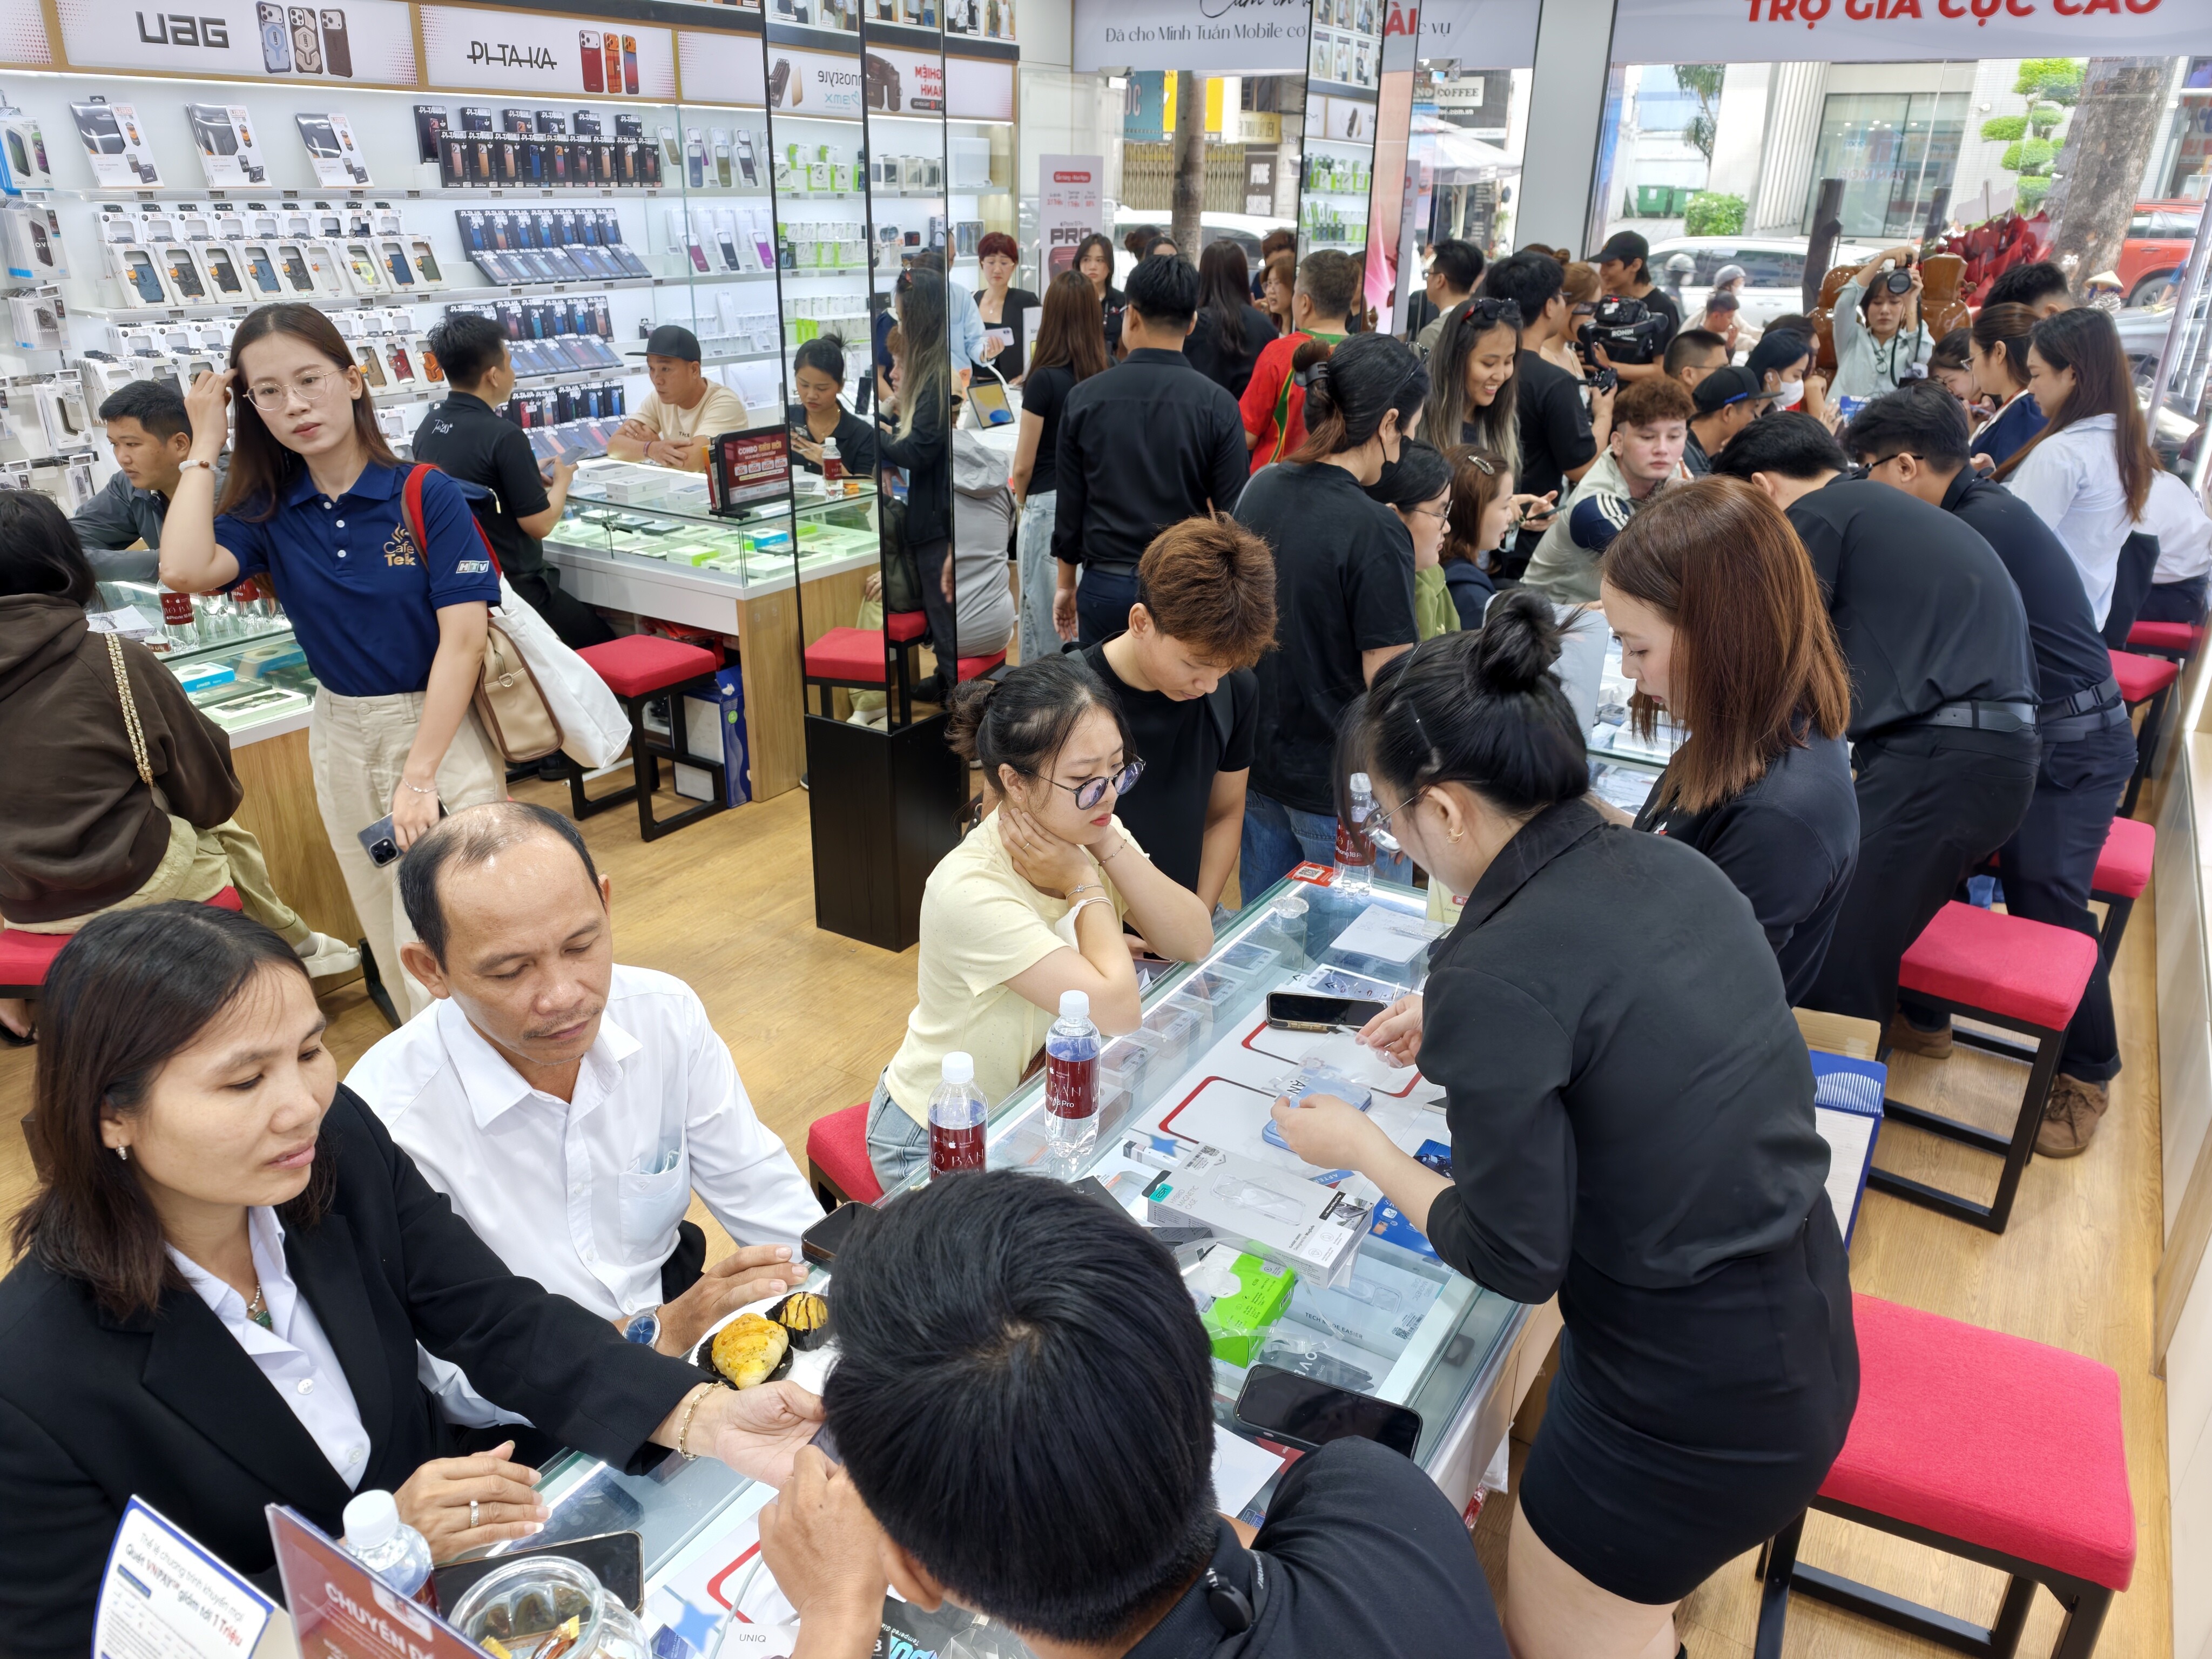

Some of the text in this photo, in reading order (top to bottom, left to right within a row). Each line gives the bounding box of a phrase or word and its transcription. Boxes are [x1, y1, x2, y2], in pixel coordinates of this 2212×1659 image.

[136, 11, 230, 48] UAG
[1128, 26, 1155, 41] cho
[1158, 25, 1191, 41] Minh
[1195, 23, 1230, 40] Tuấn
[1233, 22, 1283, 39] Mobile
[1432, 22, 1451, 37] vụ
[467, 41, 557, 70] PITAKA
[1437, 88, 1480, 97] COFFEE
[2062, 254, 2079, 265] 26
[1611, 328, 1634, 338] RONIN
[738, 445, 758, 455] COMBO
[383, 541, 415, 554] Cafe
[384, 552, 416, 567] Tek
[457, 561, 488, 572] HTV
[1051, 1081, 1081, 1097] BÁN
[952, 1149, 984, 1167] BÁN
[1170, 1189, 1185, 1204] HYBRID
[1177, 1185, 1199, 1207] MAGNETIC
[1185, 1198, 1197, 1210] CASE
[1305, 1225, 1315, 1237] MagSafe
[1305, 1312, 1321, 1322] TECH
[1342, 1326, 1363, 1339] EASIER
[218, 1618, 243, 1647] Triệu
[739, 1633, 767, 1643] UNIQ
[891, 1628, 921, 1646] Tempered
